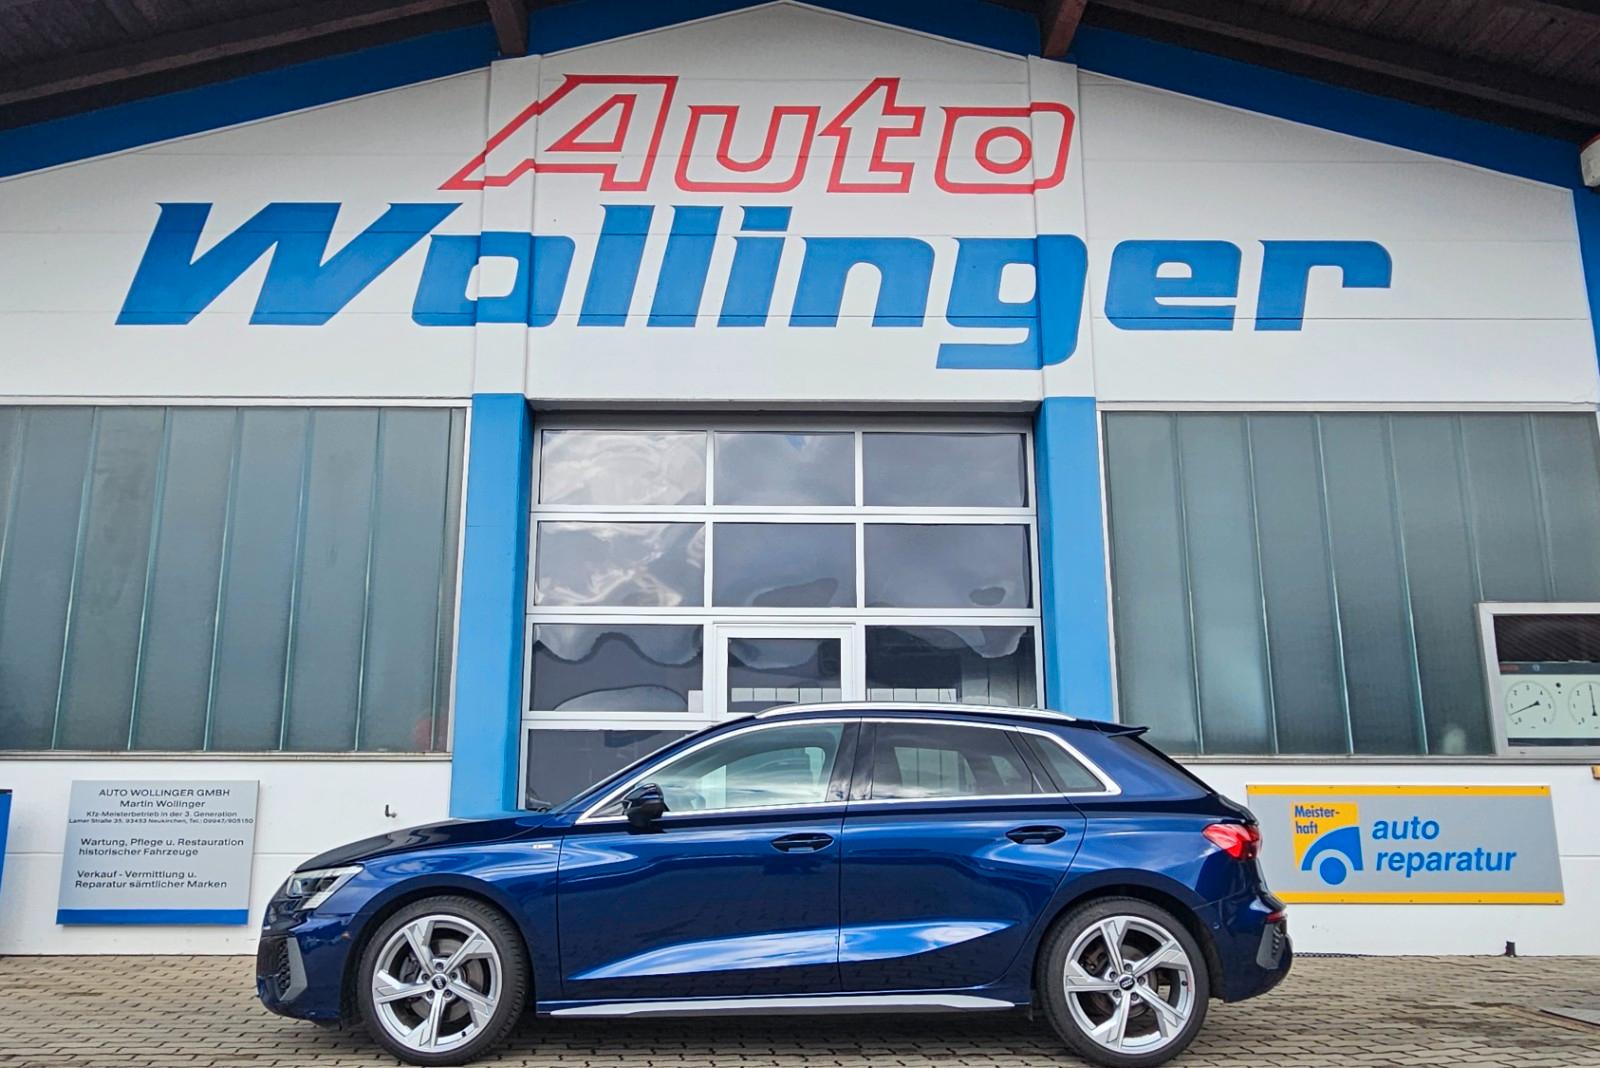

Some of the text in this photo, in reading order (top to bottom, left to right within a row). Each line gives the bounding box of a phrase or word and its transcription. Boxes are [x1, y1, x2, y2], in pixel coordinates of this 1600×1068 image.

[438, 73, 1075, 194] Auto
[115, 202, 1392, 370] Wollinger
[1294, 806, 1340, 818] Meister-
[1296, 821, 1318, 834] haft
[1372, 816, 1439, 840] auto
[125, 871, 184, 879] Vermittlung
[1376, 848, 1516, 878] reparatur
